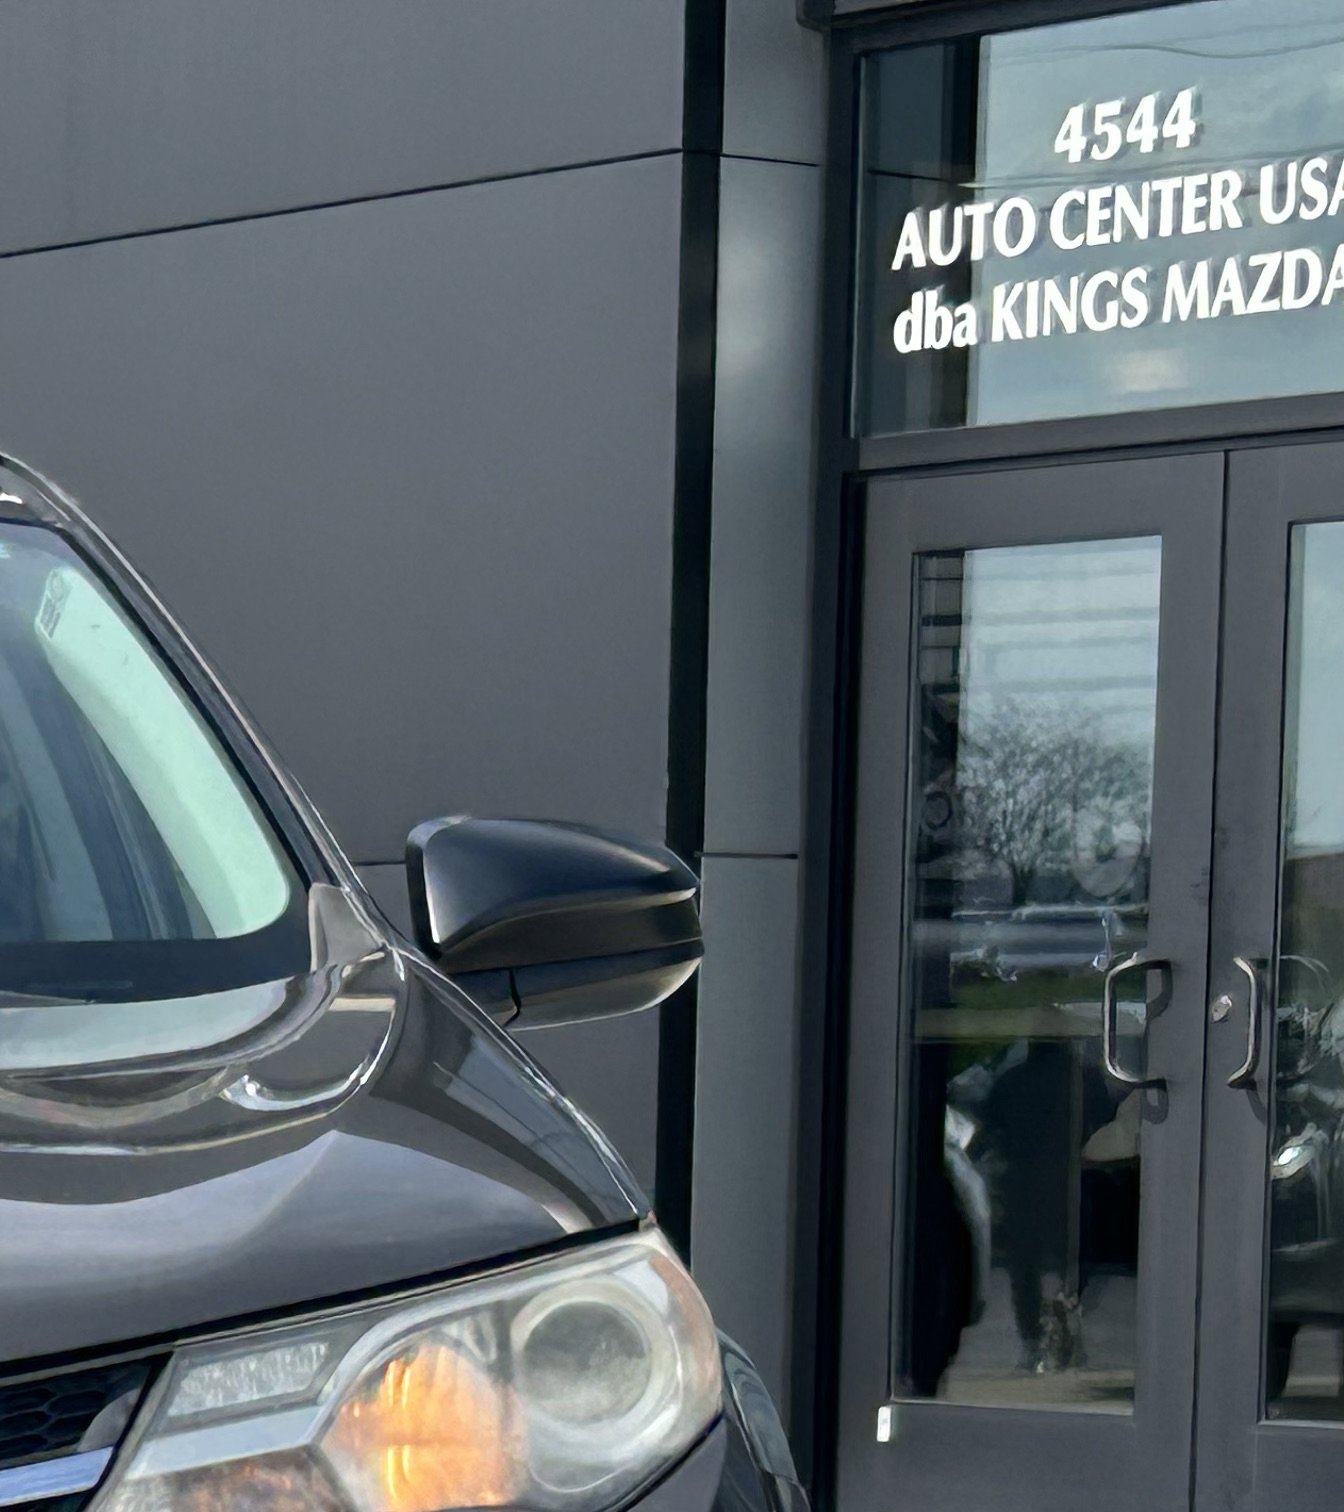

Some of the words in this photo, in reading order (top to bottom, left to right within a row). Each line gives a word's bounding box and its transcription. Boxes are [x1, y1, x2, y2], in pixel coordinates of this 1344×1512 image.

[1054, 86, 1196, 163] 4544
[891, 197, 1037, 271] AUTO
[1050, 169, 1243, 250] CENTER
[893, 289, 977, 353] dba
[991, 269, 1148, 342] KINGS
